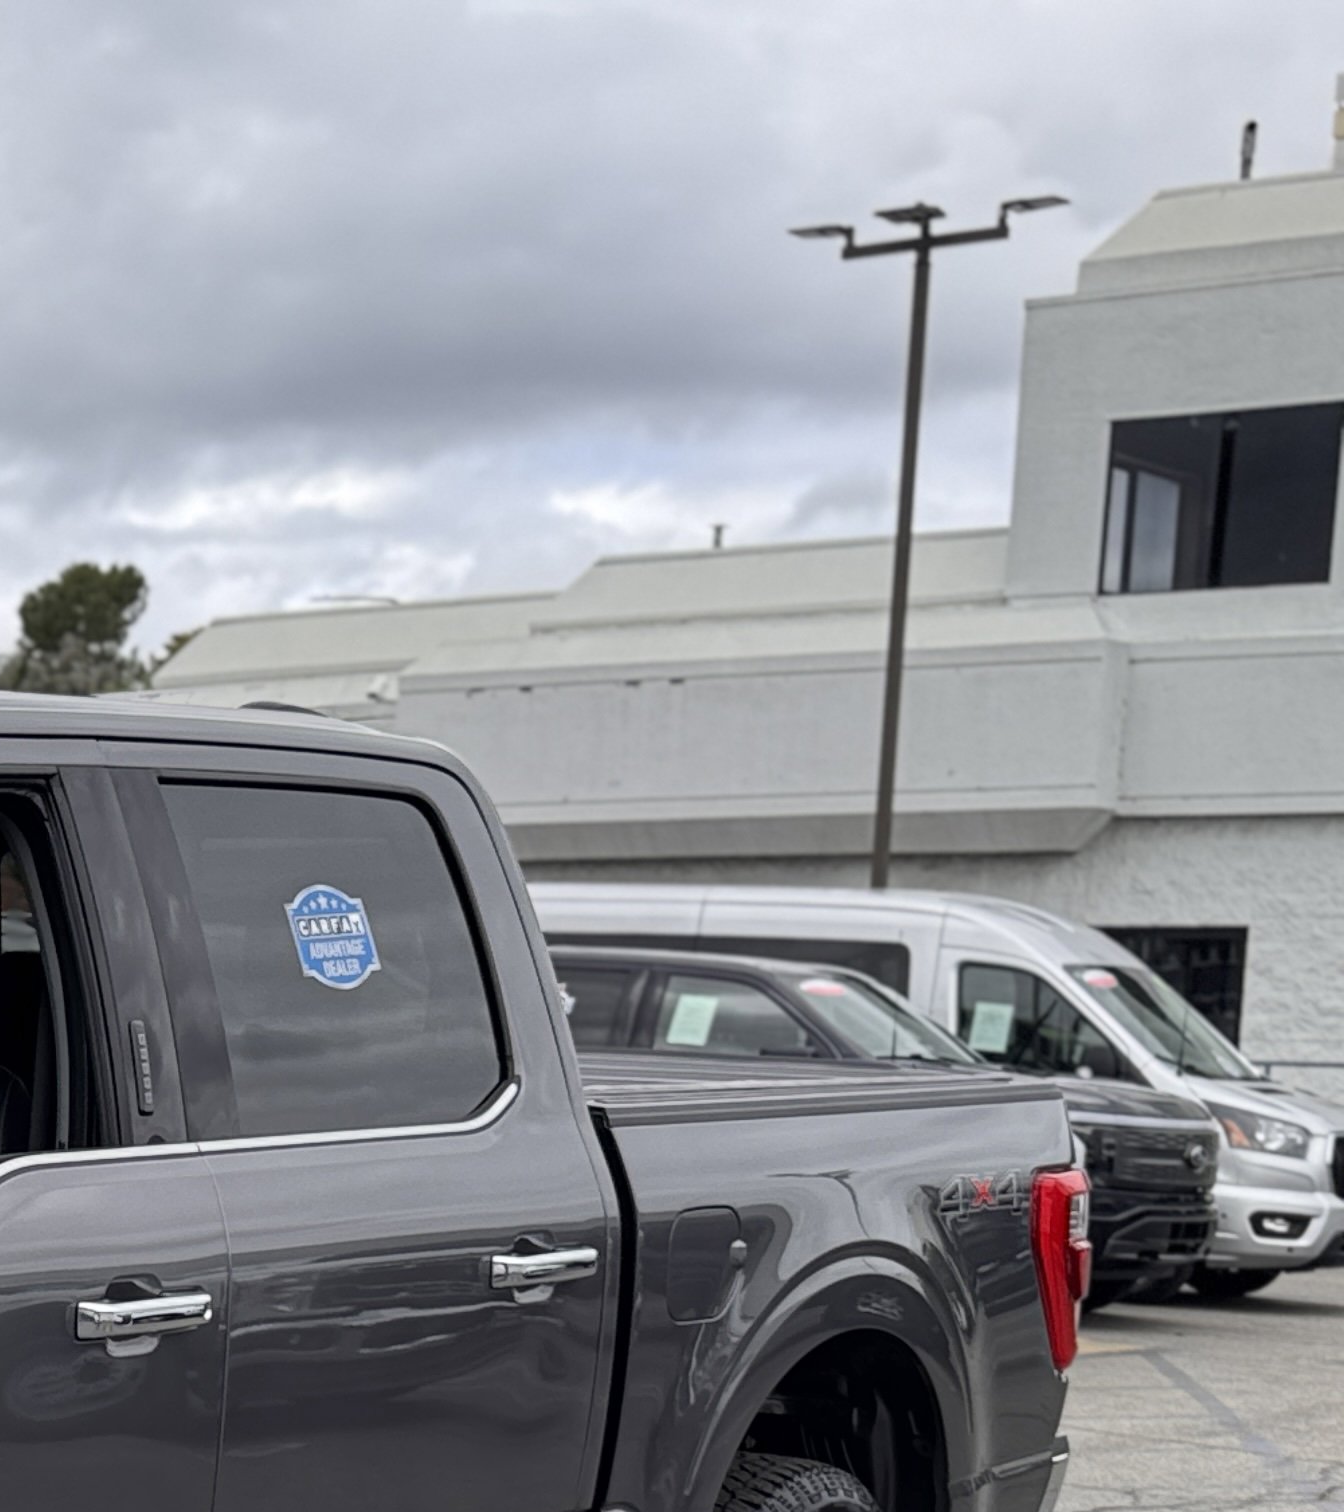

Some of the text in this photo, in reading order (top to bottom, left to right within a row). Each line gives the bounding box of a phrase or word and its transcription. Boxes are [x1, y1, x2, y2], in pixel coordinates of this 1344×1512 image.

[298, 914, 364, 936] CARFAX
[309, 938, 367, 960] ADVANTAGE
[322, 958, 362, 978] DEALER
